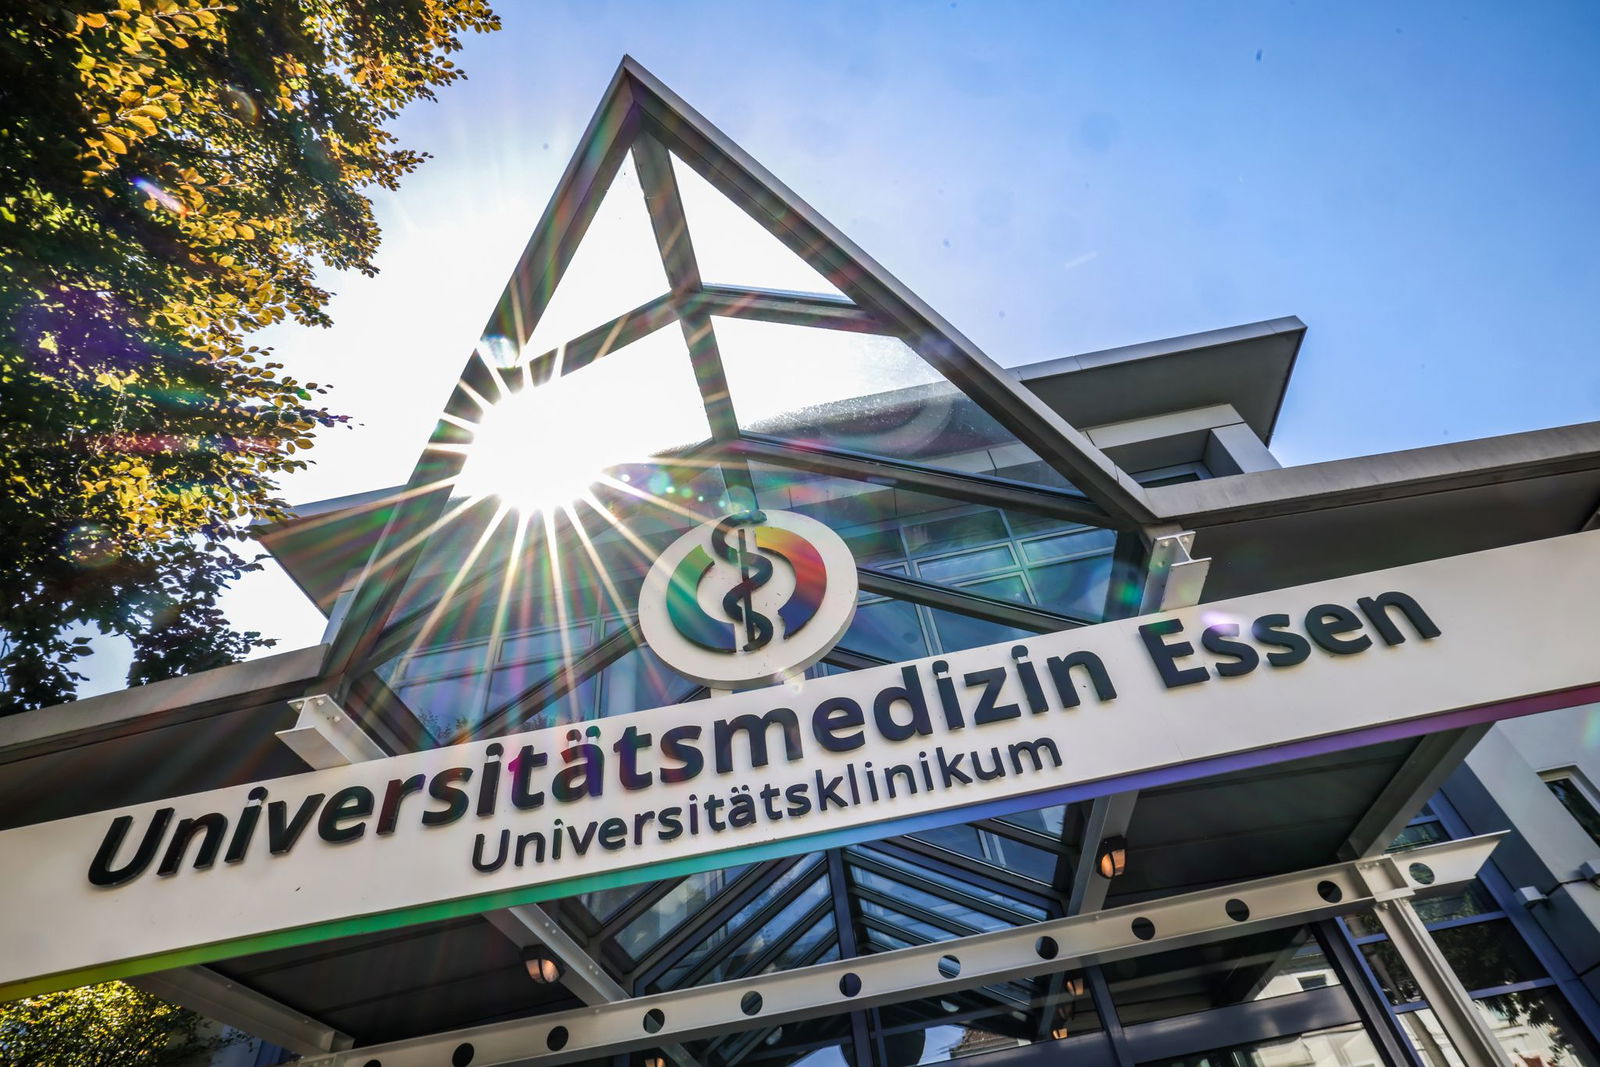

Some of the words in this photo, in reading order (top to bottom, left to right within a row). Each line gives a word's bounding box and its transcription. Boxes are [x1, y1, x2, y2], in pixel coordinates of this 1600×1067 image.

[87, 643, 1118, 889] Universitätsmedizin
[1138, 589, 1442, 689] Essen
[471, 736, 1063, 874] Universitätsklinikum
